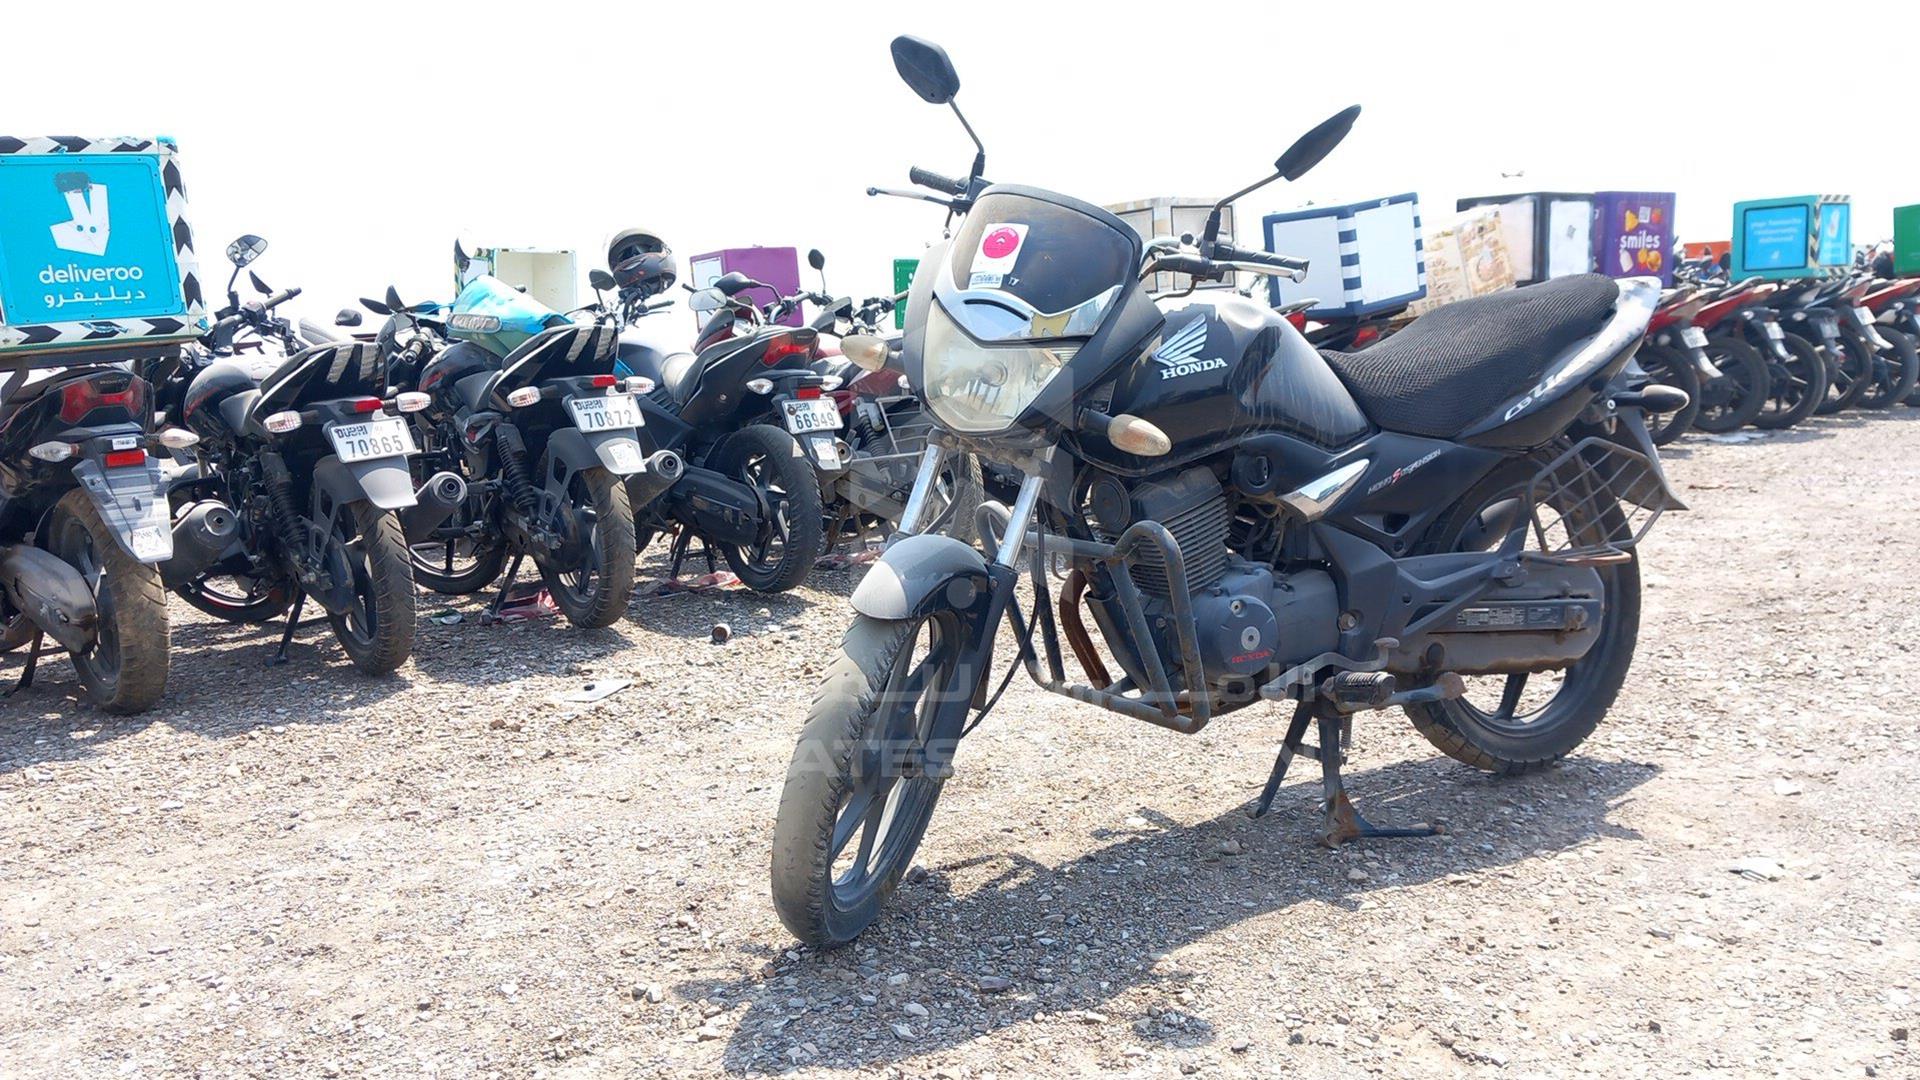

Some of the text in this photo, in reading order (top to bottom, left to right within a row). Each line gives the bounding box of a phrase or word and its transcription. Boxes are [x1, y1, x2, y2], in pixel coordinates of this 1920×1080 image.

[1620, 230, 1660, 249] smiles
[39, 263, 143, 284] deliveroo
[44, 286, 146, 308] ديليفرو
[1160, 358, 1228, 380] HONDA
[584, 409, 635, 428] 70872
[794, 412, 836, 430] 66949
[345, 434, 404, 458] 70865
